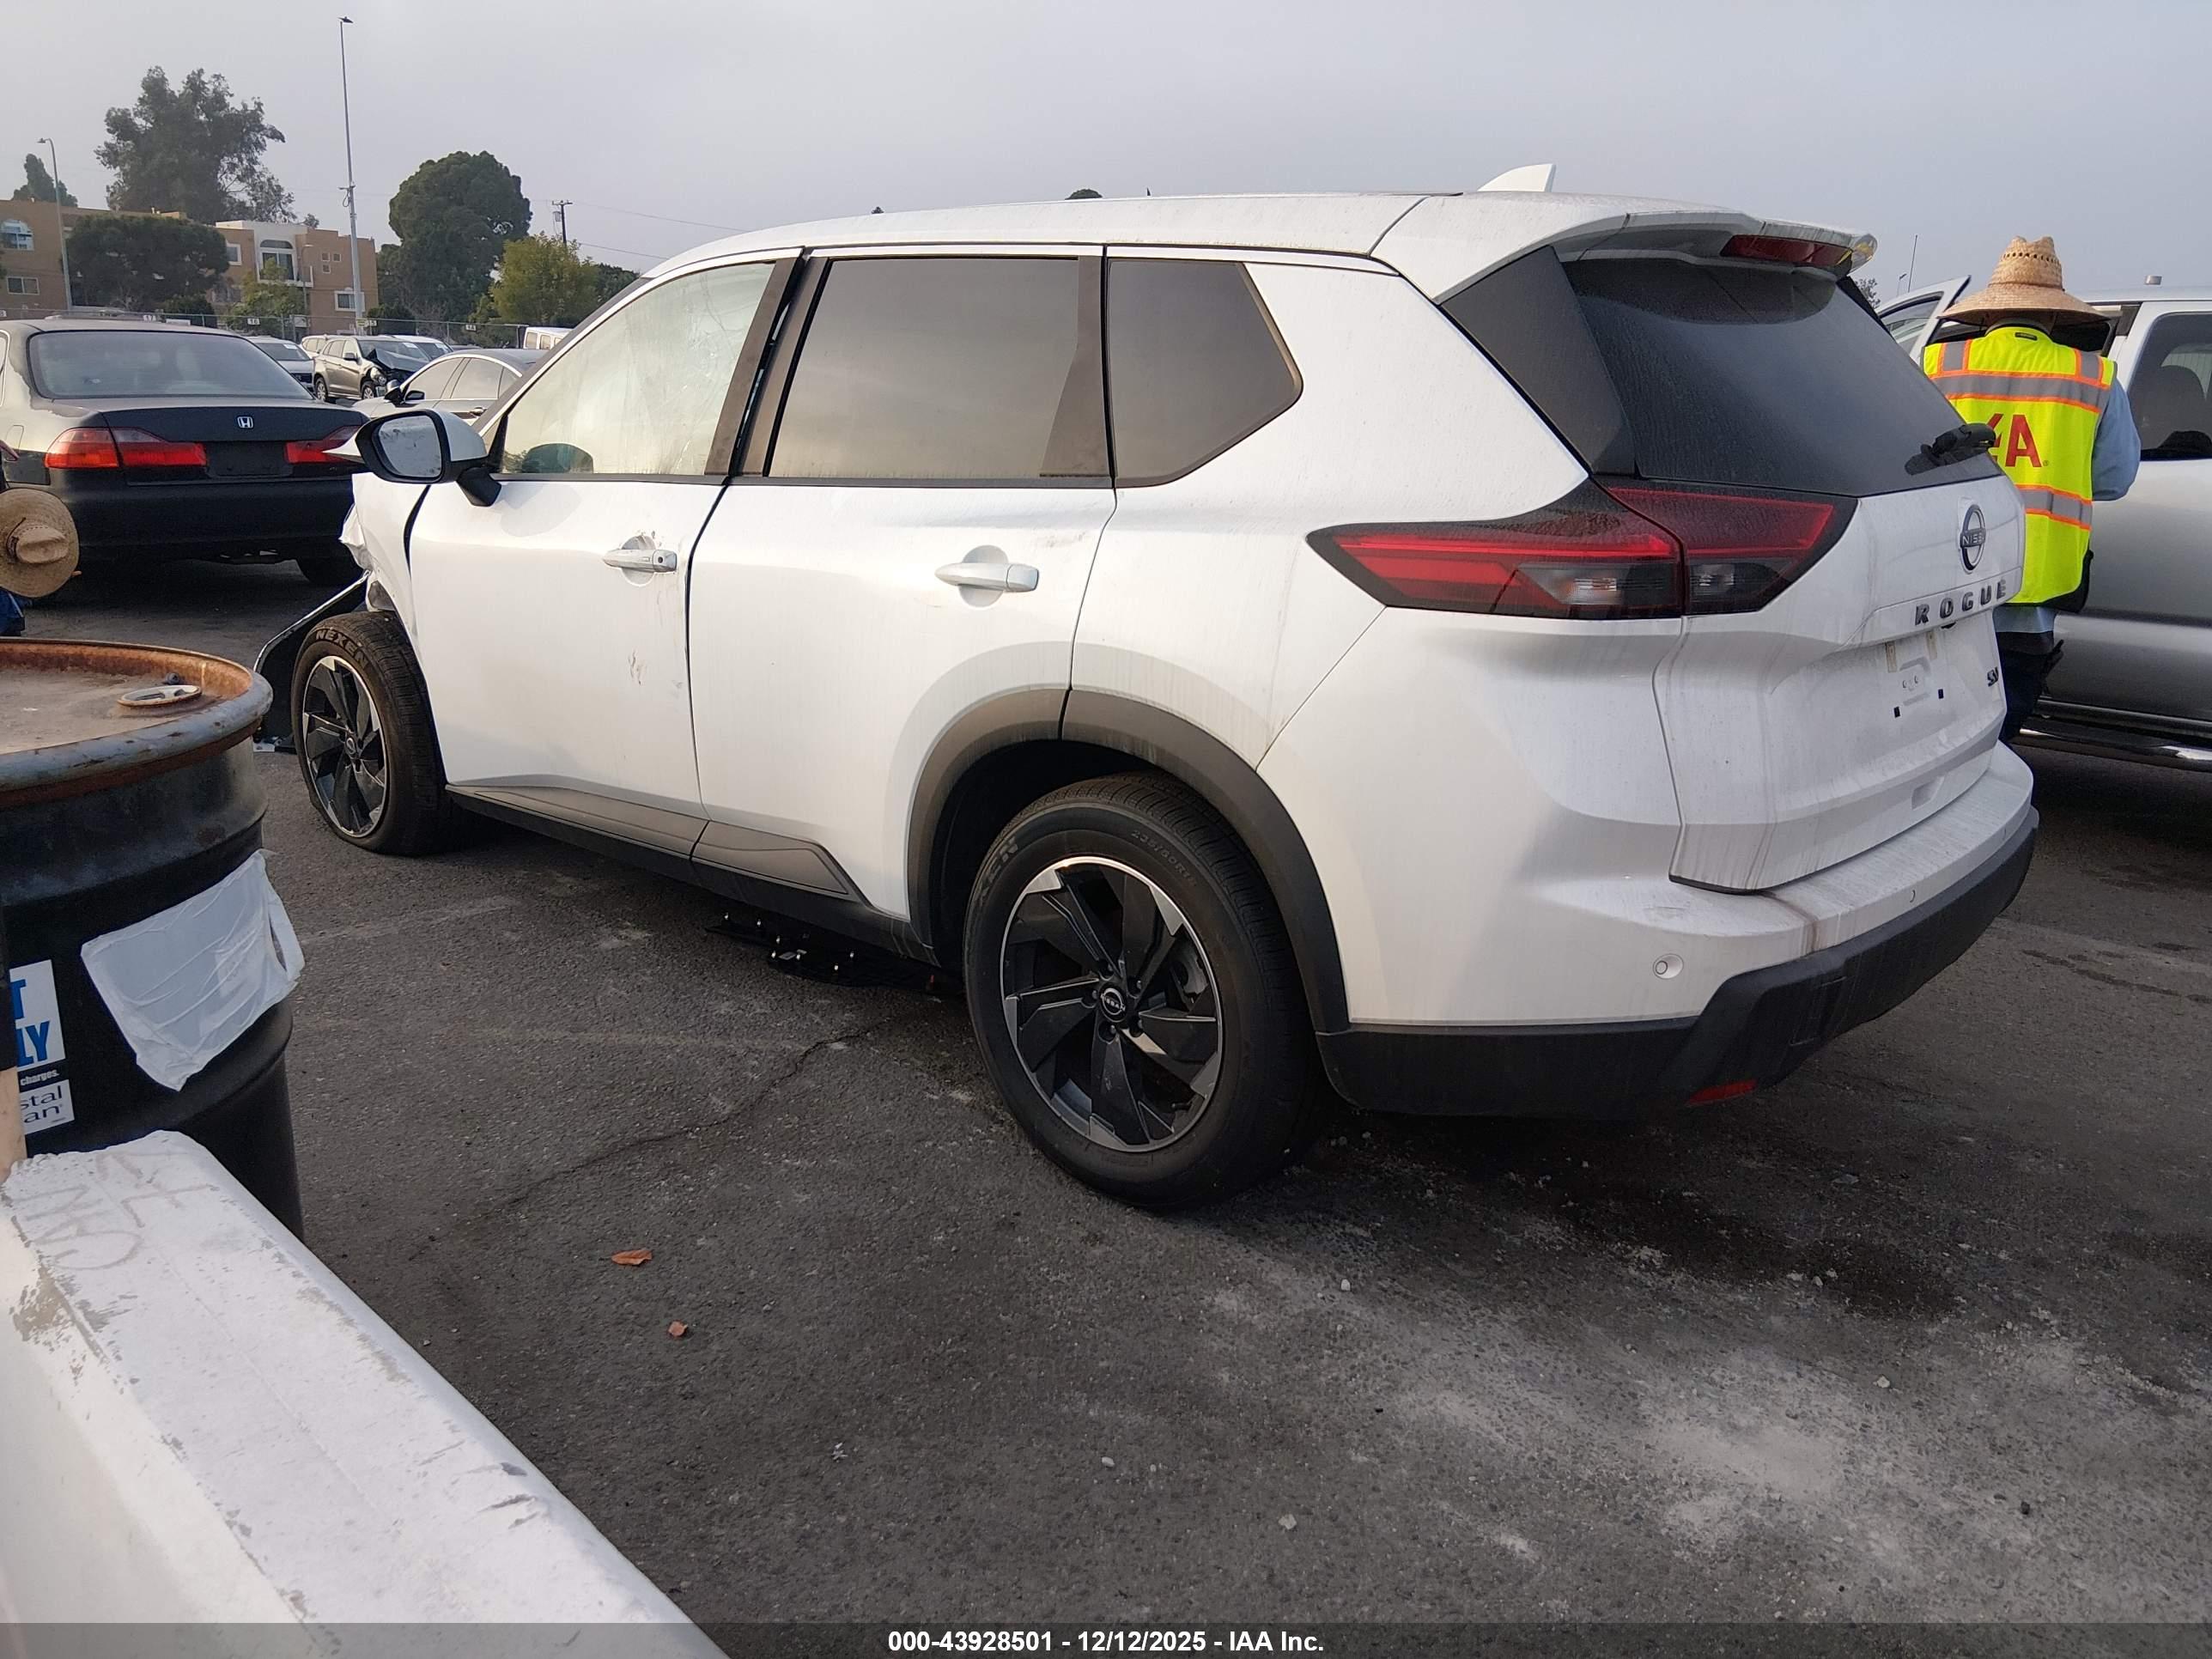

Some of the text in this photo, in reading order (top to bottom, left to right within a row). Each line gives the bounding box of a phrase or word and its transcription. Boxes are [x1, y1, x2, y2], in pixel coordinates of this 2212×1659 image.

[1915, 579, 2007, 625] ROGUE
[315, 629, 369, 670] NEXEN
[1987, 666, 1999, 686] SV
[20, 1069, 60, 1085] charges.
